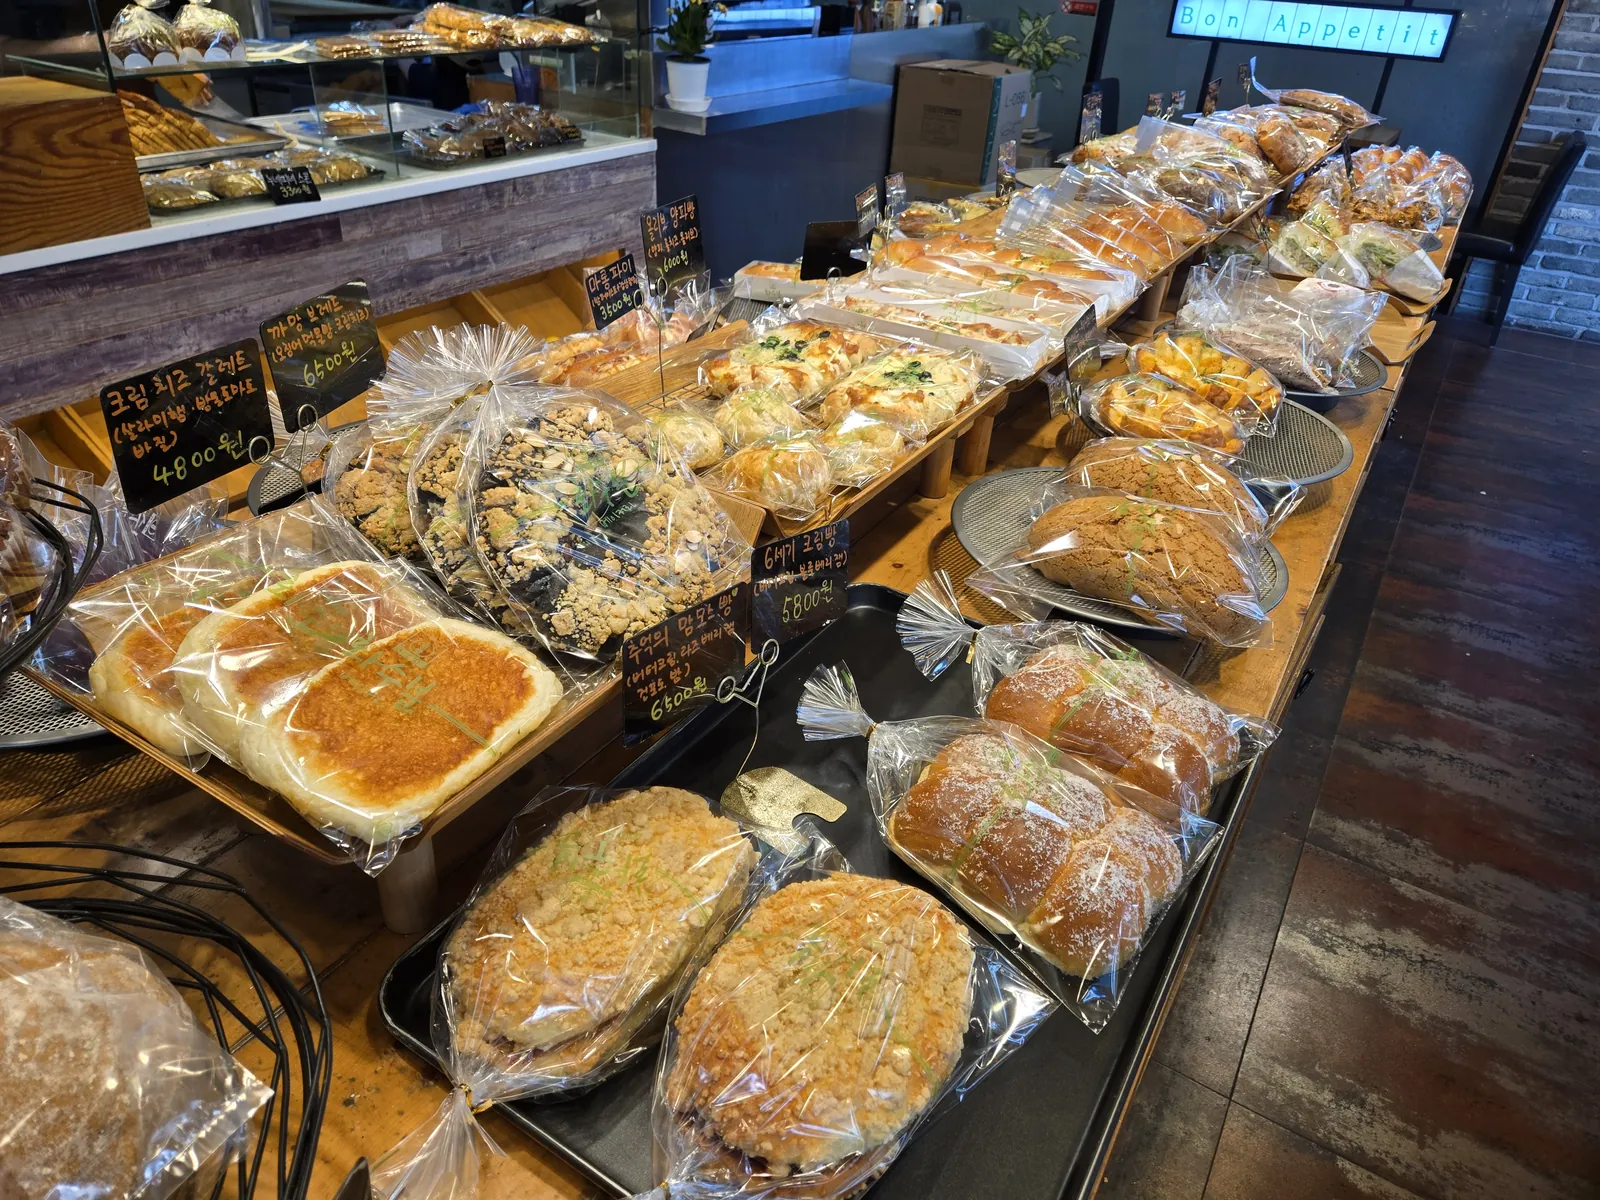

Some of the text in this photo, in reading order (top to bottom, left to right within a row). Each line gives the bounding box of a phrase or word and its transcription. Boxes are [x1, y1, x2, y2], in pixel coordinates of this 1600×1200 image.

[1180, 6, 1439, 46] Bon Appetit
[663, 249, 689, 273] 6000원
[267, 295, 344, 339] 까망 브레드
[599, 292, 633, 321] 3500원
[303, 340, 358, 387] 6500원
[153, 430, 249, 486] 4800원
[764, 525, 837, 570] 6세기 크림빵
[782, 579, 834, 623] 5800원
[627, 625, 670, 665] 추억의
[650, 676, 708, 721] 6500원
